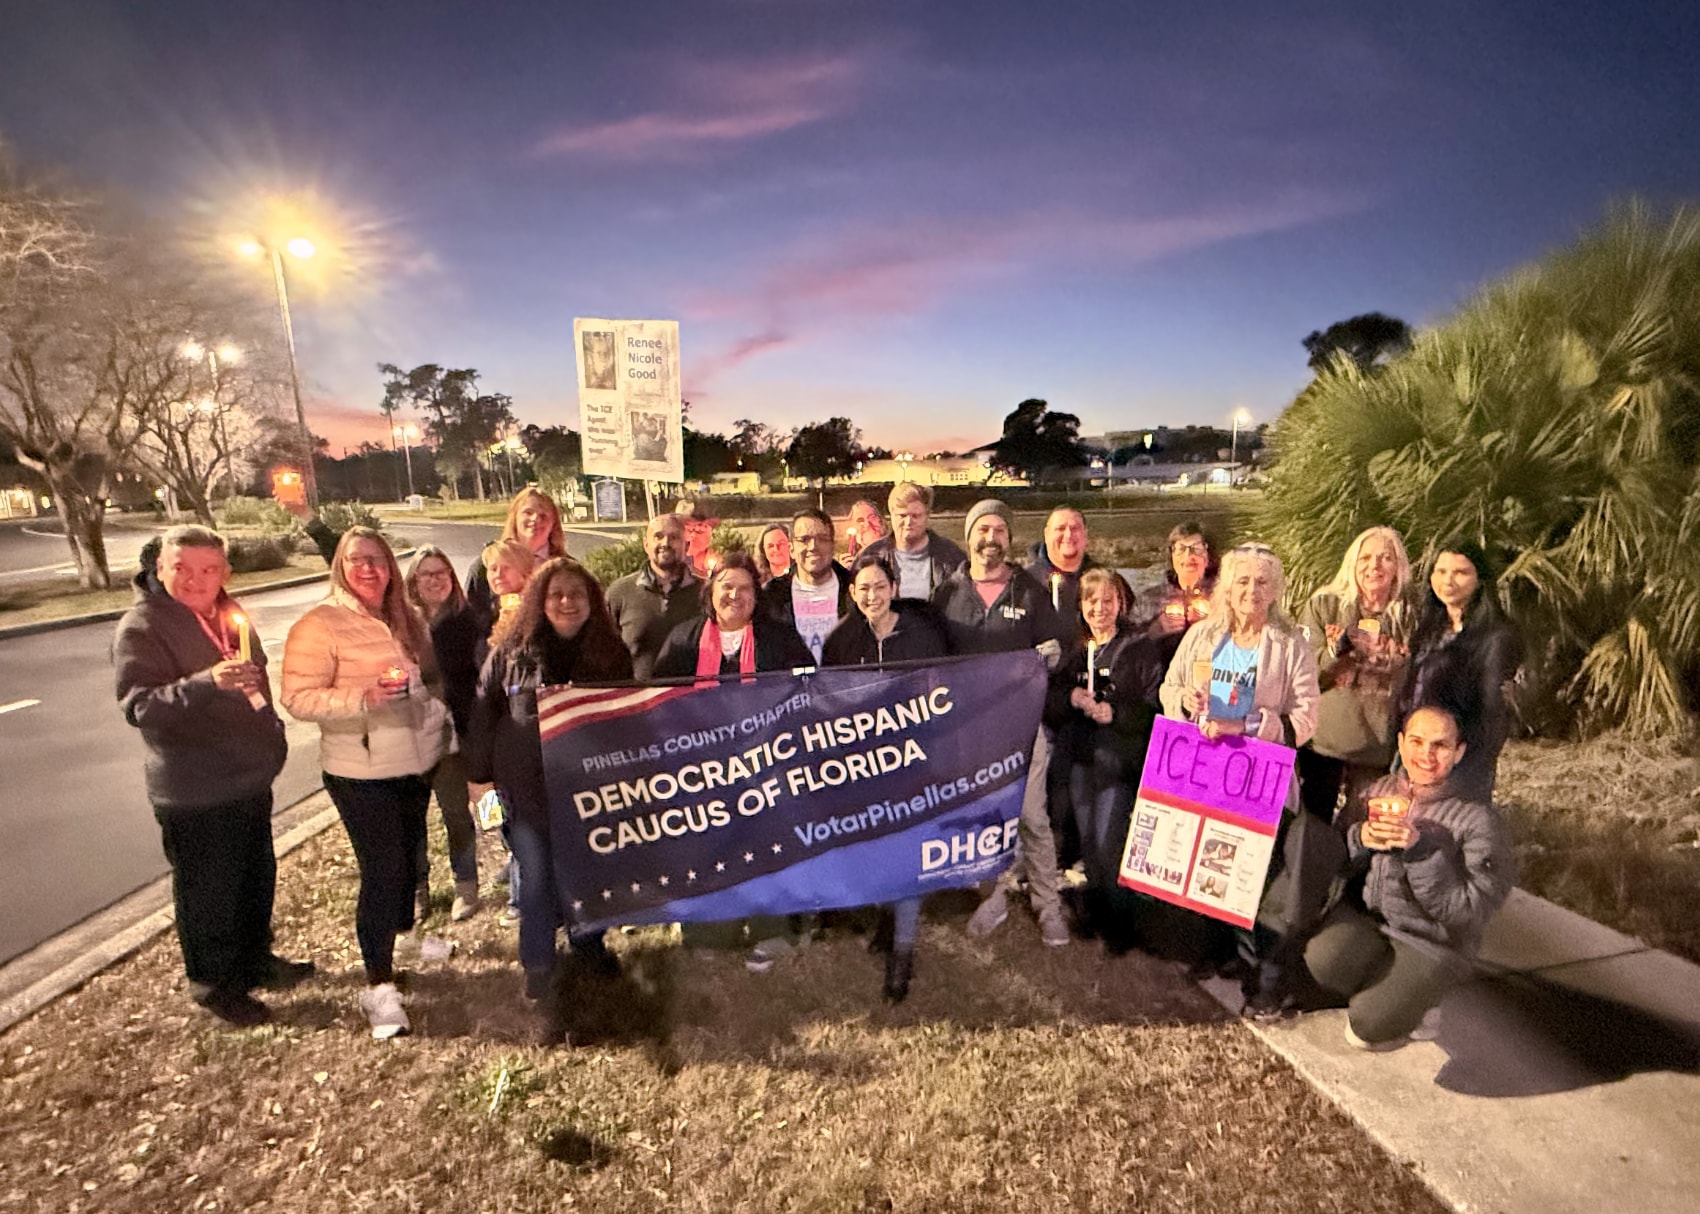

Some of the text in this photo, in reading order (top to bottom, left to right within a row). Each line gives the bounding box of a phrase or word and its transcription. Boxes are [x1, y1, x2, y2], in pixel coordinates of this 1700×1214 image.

[627, 337, 662, 349] Renee
[628, 352, 663, 364] Nicole
[628, 368, 656, 379] Good
[586, 404, 613, 414] The ICE
[573, 686, 954, 820] DEMOCRATIC HISPANIC
[582, 692, 812, 773] PINELLAS COUNTY CHAPTER
[588, 738, 928, 854] CAUCUS OF FLORIDA
[794, 749, 1025, 847] VotarPinellas.com
[1156, 731, 1292, 807] ICE OUT
[921, 817, 1020, 872] DHCF
